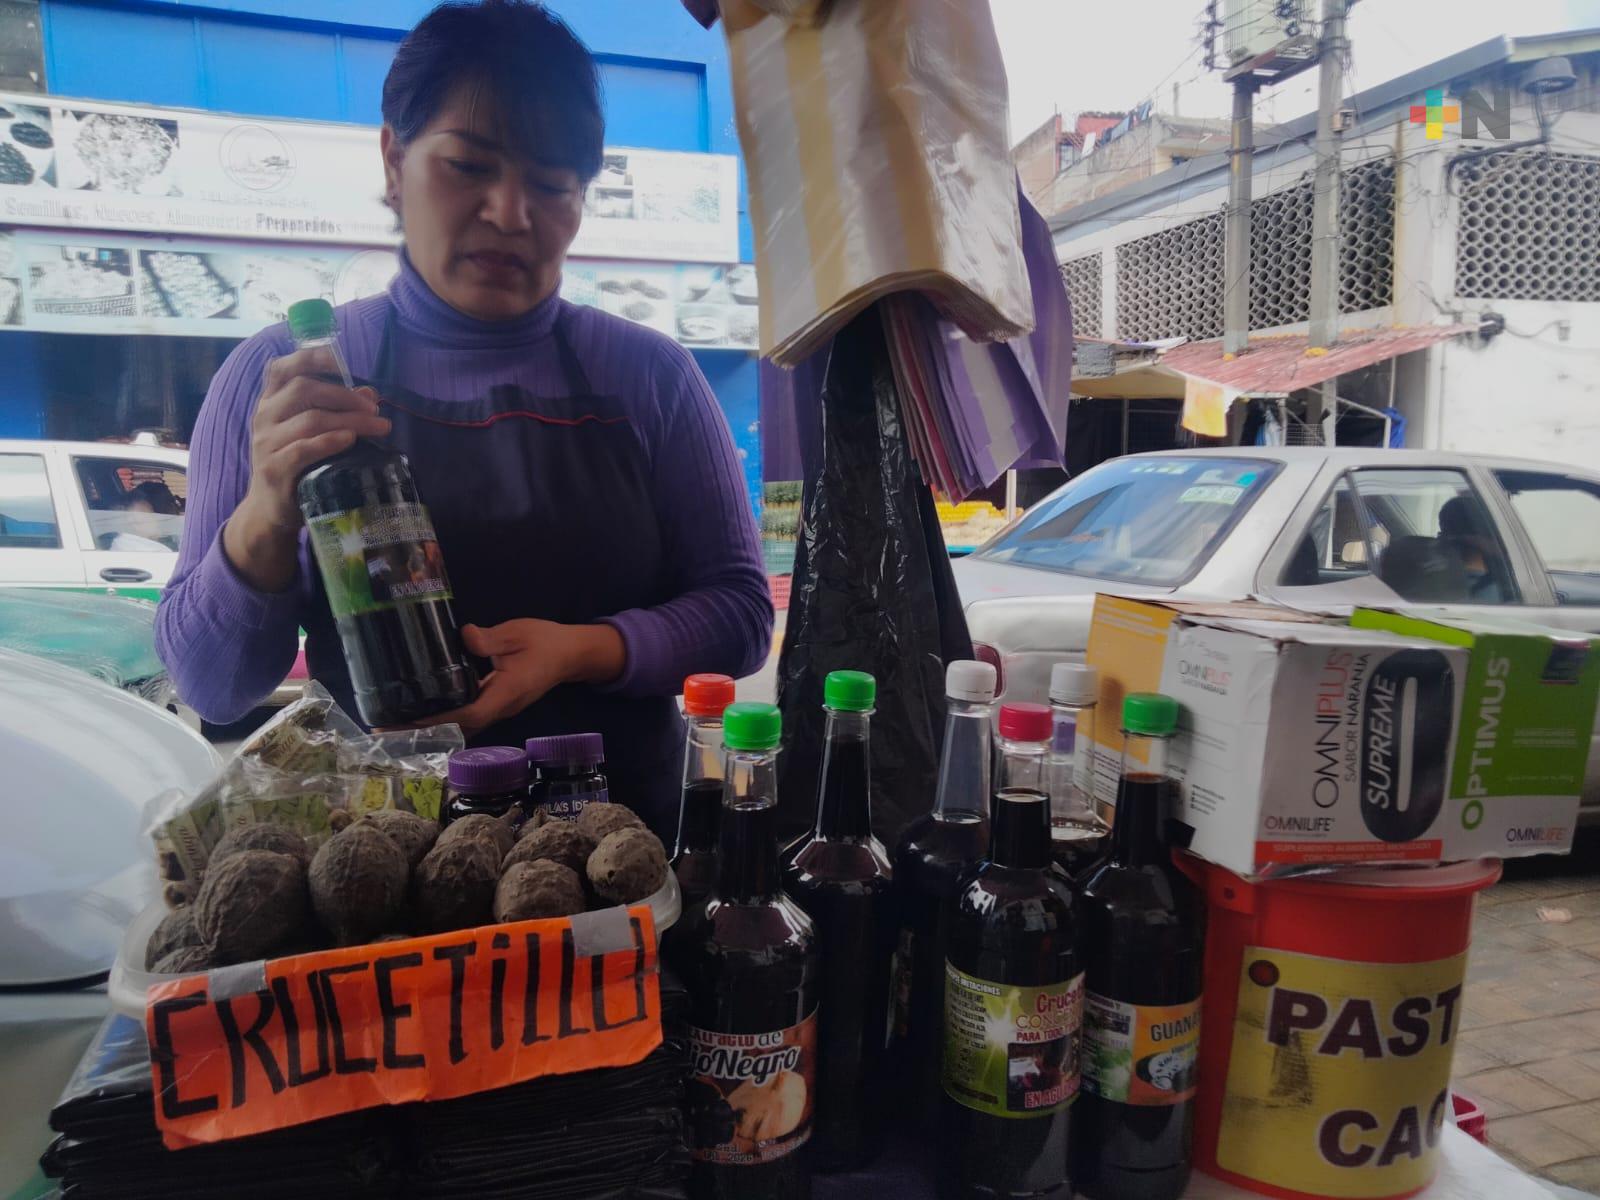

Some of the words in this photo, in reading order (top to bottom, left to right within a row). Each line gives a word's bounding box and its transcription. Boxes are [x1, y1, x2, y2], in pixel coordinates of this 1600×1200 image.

[1345, 653, 1371, 726] NARANJA
[1312, 650, 1354, 809] OMNIPLUS
[1343, 730, 1359, 783] SABOR
[1367, 674, 1397, 810] SUPREME
[1460, 655, 1511, 832] OPTIMUS
[1264, 815, 1332, 834] OMNILIFE
[1506, 827, 1564, 844] OMNILIFE
